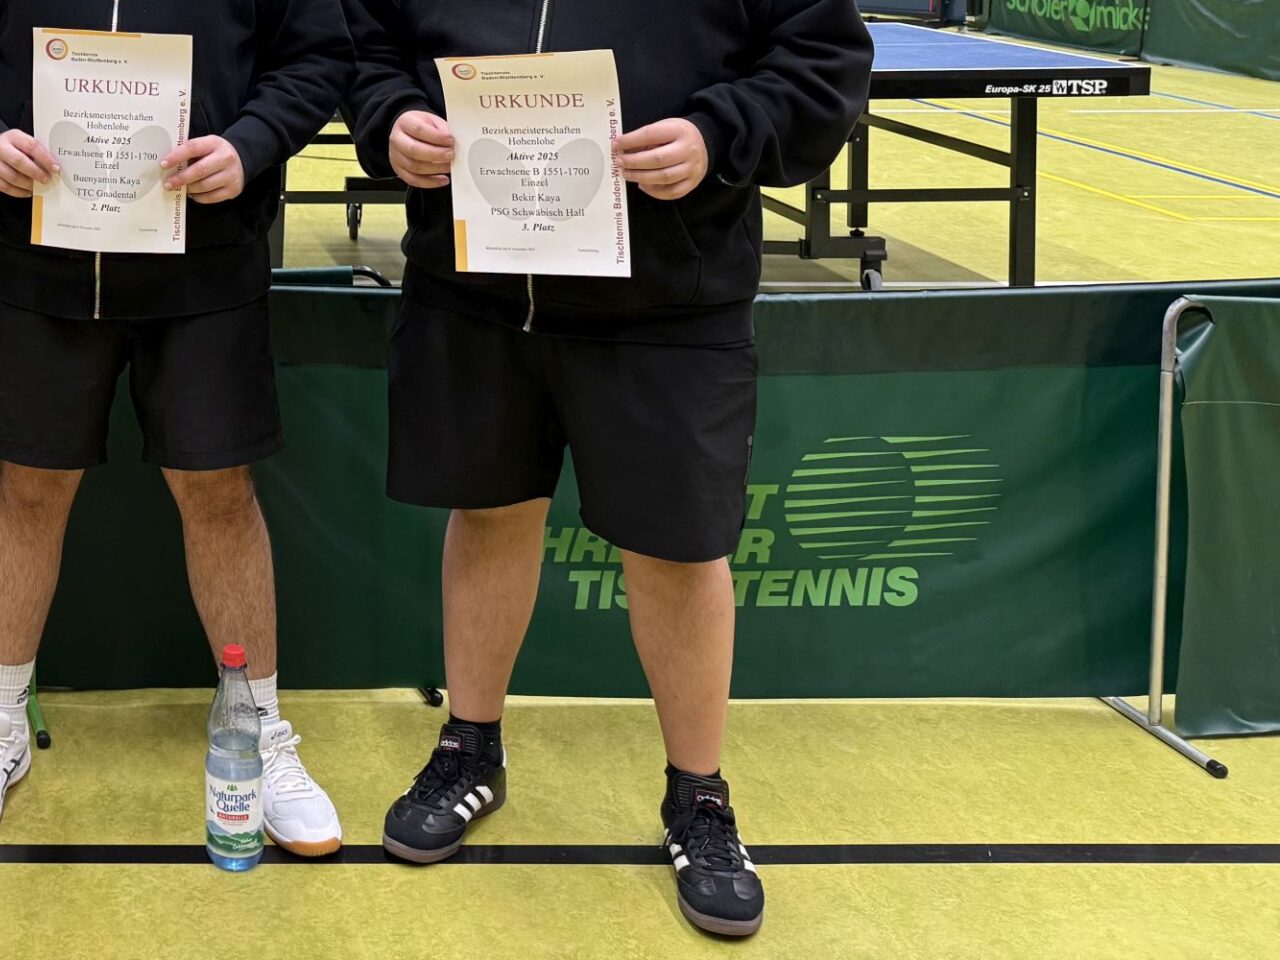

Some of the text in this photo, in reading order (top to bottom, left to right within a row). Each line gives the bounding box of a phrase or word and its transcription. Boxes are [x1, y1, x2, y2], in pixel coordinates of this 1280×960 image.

[64, 78, 160, 97] URKUNDE
[984, 79, 1108, 95] Europa-SK 25 TSP
[478, 93, 585, 109] URKUNDE
[63, 109, 154, 122] Bezirksmeisterschaften
[86, 121, 130, 131] Hohenlohe
[481, 125, 581, 135] Bezirksmeisterschaften
[83, 135, 132, 145] Aktive 2025
[508, 136, 555, 146] Hohenlohe
[58, 147, 158, 161] Erwachsene B 1551-1700
[506, 152, 559, 161] Aktive 2025
[94, 160, 120, 170] Einzel
[479, 167, 590, 176] Erwachsene B 1551-1700
[73, 173, 141, 187] Buenyamin Kaya
[521, 178, 549, 187] Einzel
[76, 188, 137, 199] TTC Gnadental
[511, 193, 561, 204] Bekir Kaya
[90, 203, 121, 213] 2. Platz
[490, 207, 585, 217] PSG Schwäbisch Hall
[172, 193, 182, 242] Tischtennis
[521, 223, 556, 232] 3. Platz
[616, 212, 625, 265] Tischtennis
[568, 566, 919, 610] TITENNIS
[209, 783, 257, 805] Naturpark
[216, 799, 250, 812] Quelle
